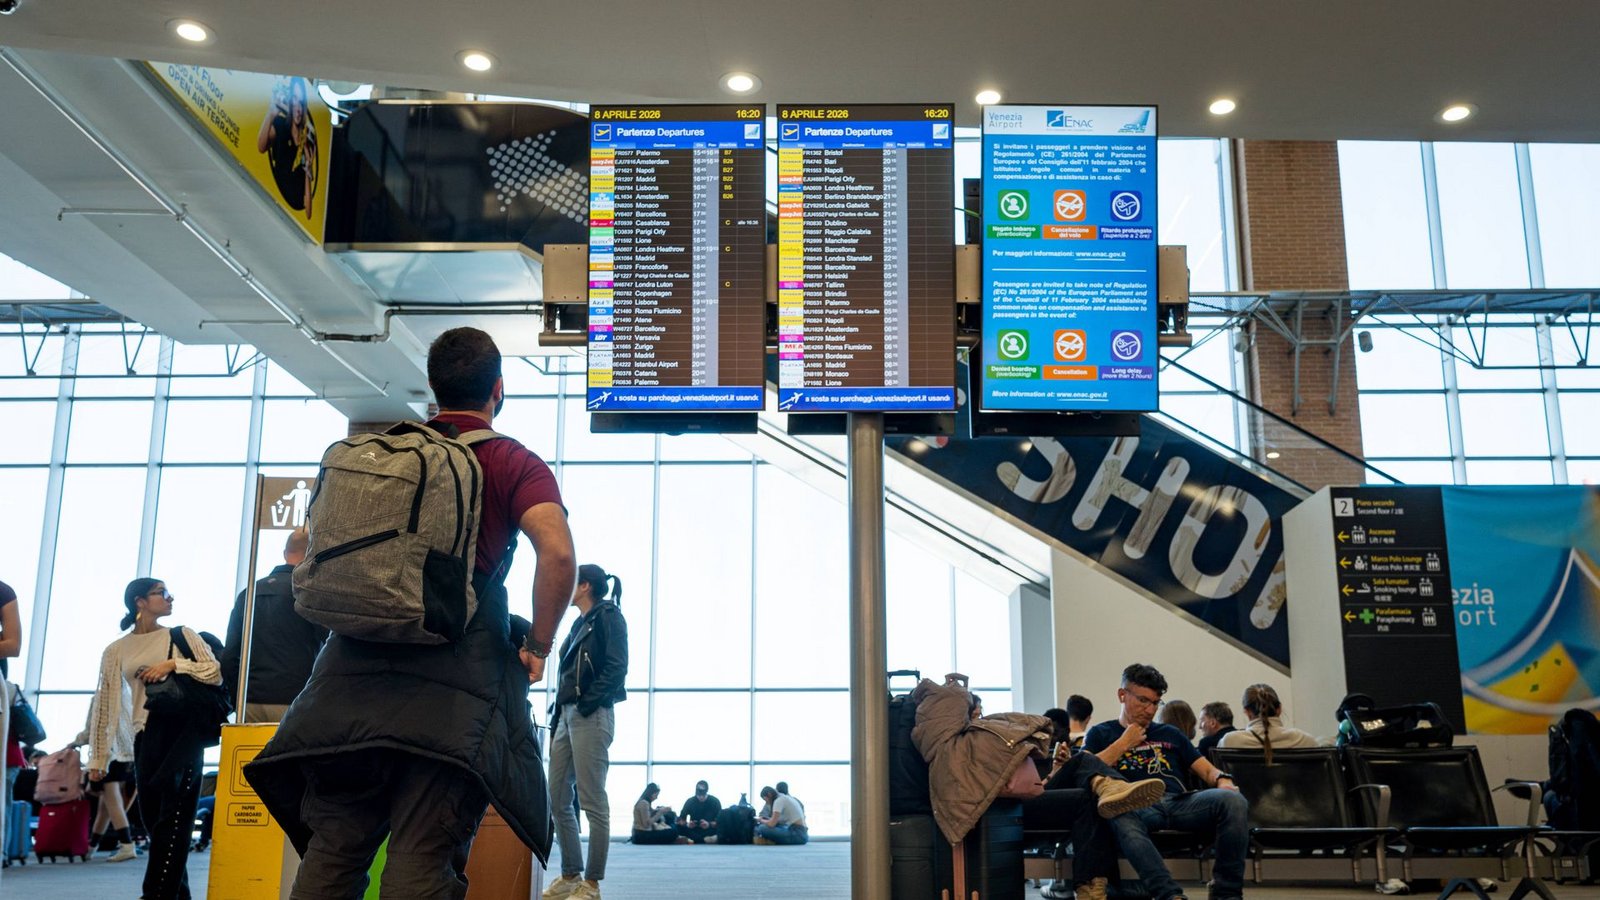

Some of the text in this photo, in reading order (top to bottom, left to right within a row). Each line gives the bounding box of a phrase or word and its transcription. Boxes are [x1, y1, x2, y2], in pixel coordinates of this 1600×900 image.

[202, 69, 224, 101] Floor
[169, 65, 239, 148] OPEN AIR TERRACE
[195, 81, 240, 136] DRINKS LOUNGE
[595, 110, 760, 119] 8 APRILE 2026 16:20
[790, 110, 824, 118] APRILE
[827, 110, 848, 118] 2026
[924, 109, 948, 118] 16:20
[989, 112, 1022, 121] Venezia
[989, 121, 1022, 129] Airport
[617, 128, 705, 138] Partenze Departures
[805, 128, 893, 137] Partenze Departures
[635, 343, 653, 351] Zurigo
[648, 395, 734, 403] parcheggi.veneziaairport.it
[841, 395, 926, 403] parcheggi.veneziaairport.it
[1340, 500, 1348, 514] 2
[996, 436, 1287, 630] SHO
[1451, 582, 1494, 605] ezia
